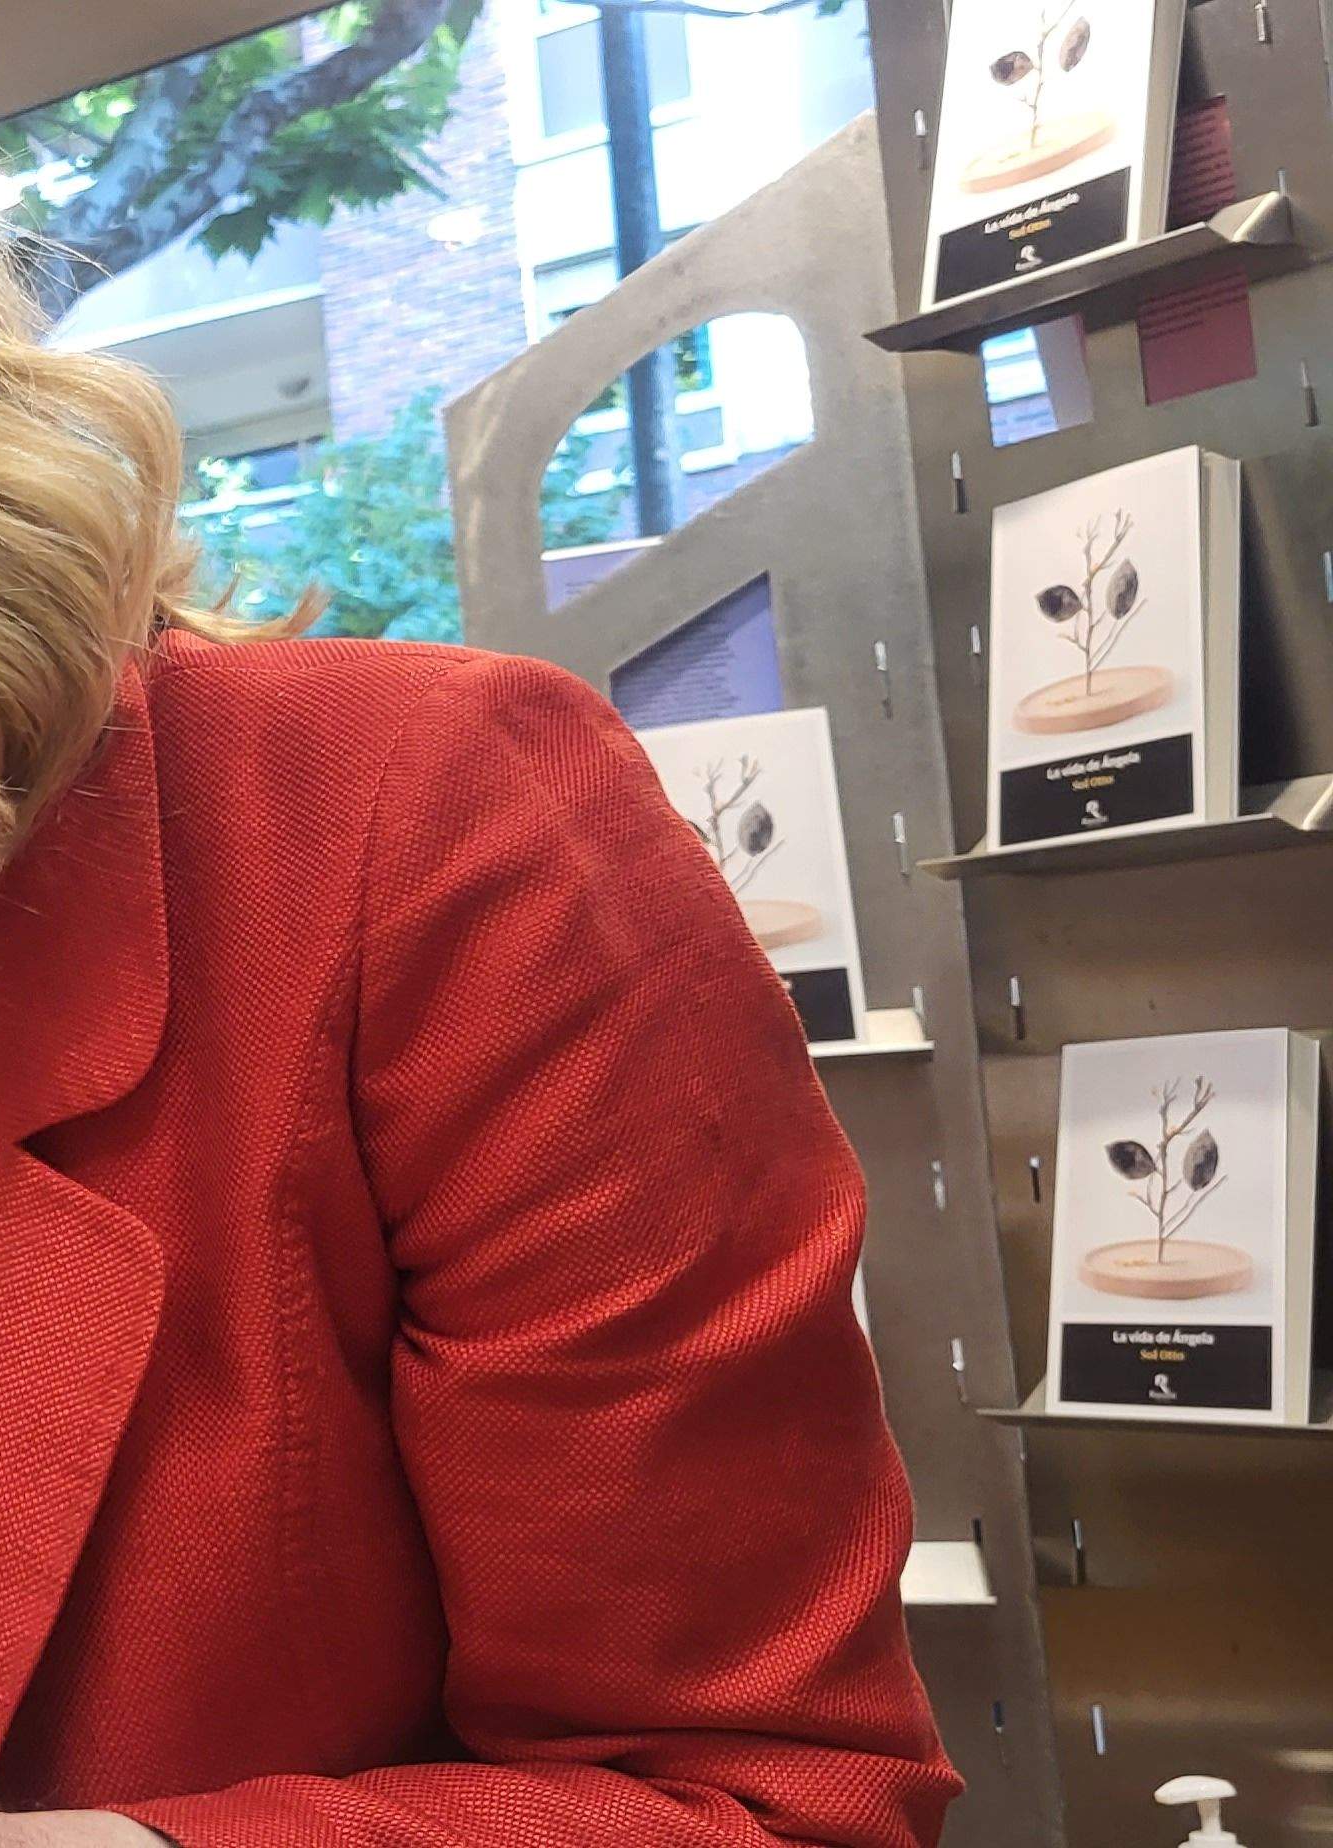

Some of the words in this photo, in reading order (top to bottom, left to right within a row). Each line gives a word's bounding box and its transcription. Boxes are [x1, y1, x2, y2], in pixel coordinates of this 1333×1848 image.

[1112, 1330, 1128, 1344] La
[1128, 1330, 1154, 1344] vida
[1154, 1330, 1171, 1344] de
